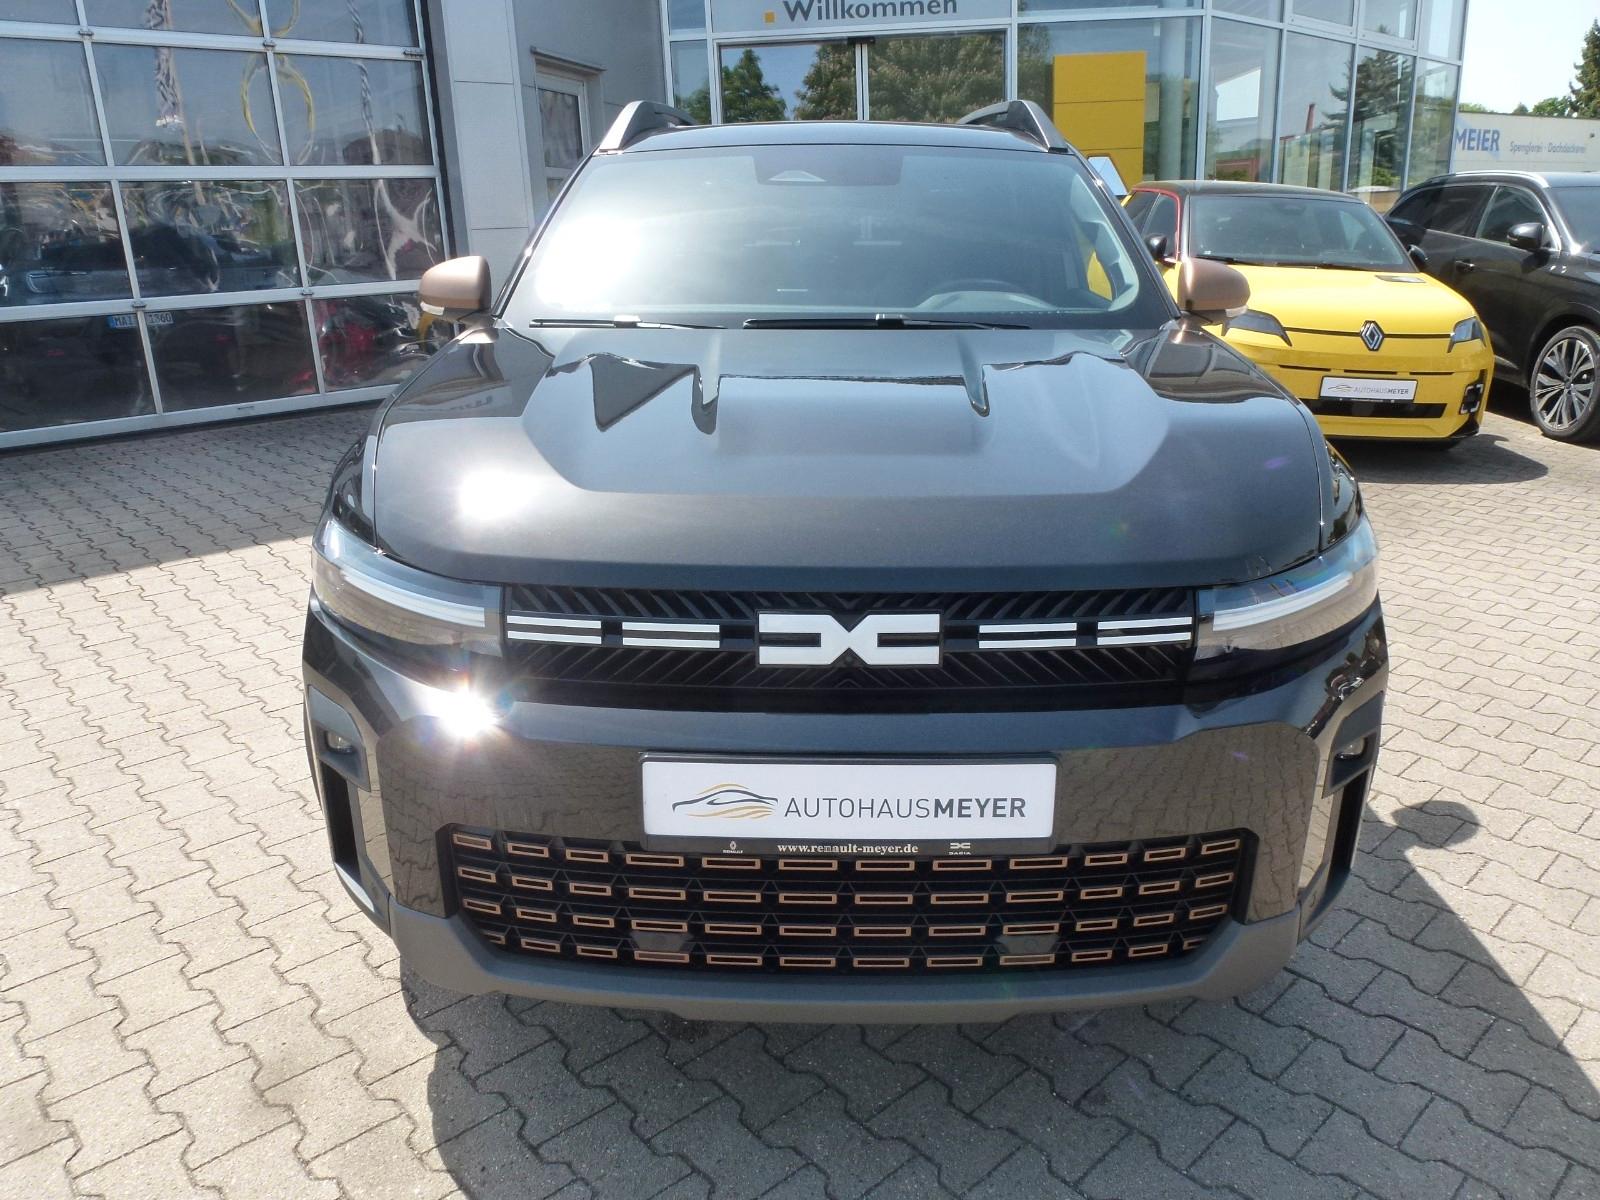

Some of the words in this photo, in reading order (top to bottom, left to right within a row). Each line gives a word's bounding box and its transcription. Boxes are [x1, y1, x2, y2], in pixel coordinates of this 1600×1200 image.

[783, 0, 958, 22] Willkommen
[1353, 386, 1409, 395] AUTOHAUSMEYER
[784, 797, 1027, 819] AUTOHAUSMEYER
[777, 843, 919, 856] www.renault-meyer.de
